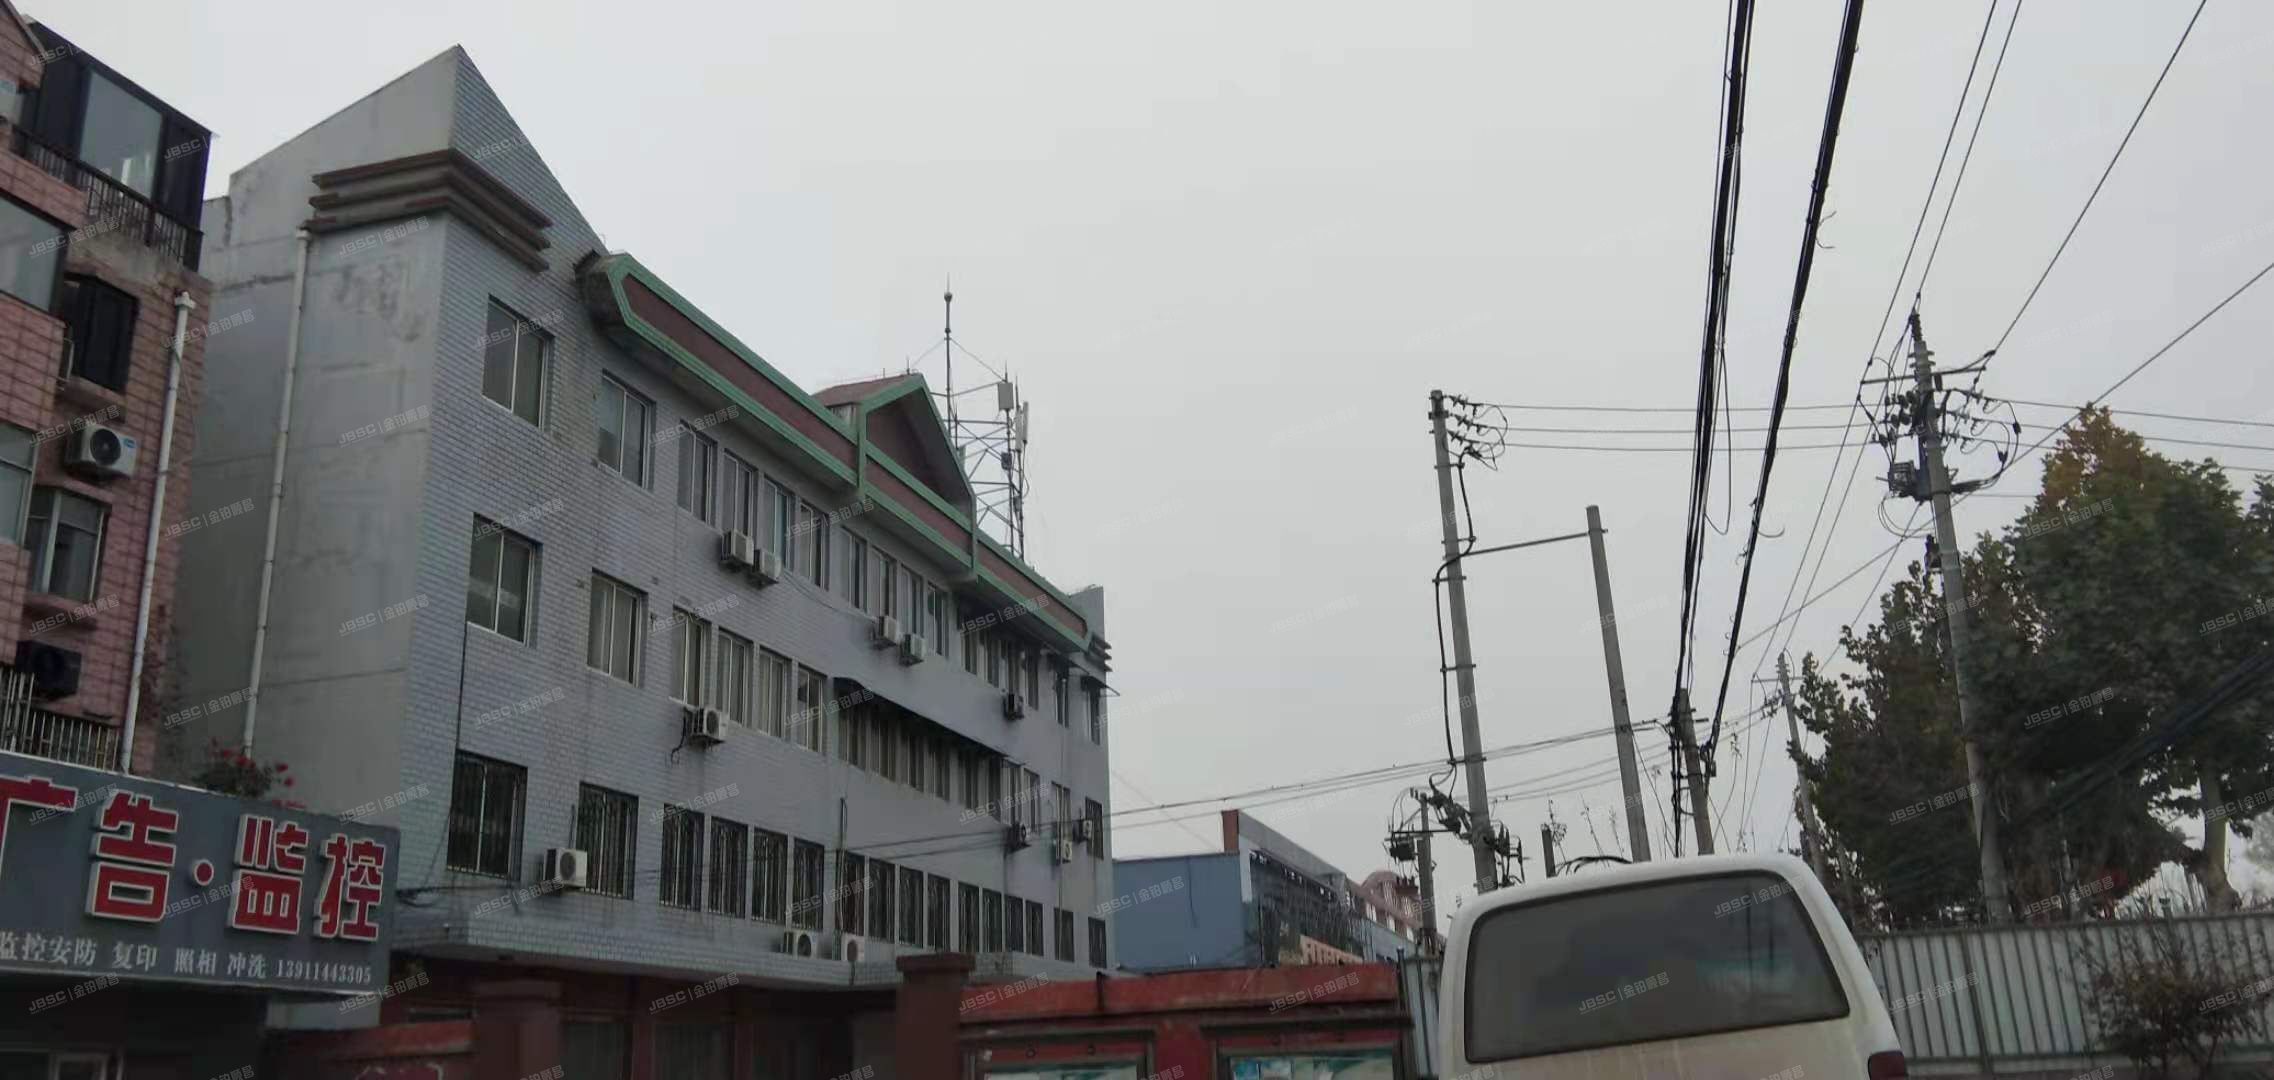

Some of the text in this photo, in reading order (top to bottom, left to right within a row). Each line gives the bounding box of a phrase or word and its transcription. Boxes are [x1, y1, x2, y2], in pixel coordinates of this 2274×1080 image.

[0, 931, 371, 984] 监控安防 复印 照相 冲洗 13911443305
